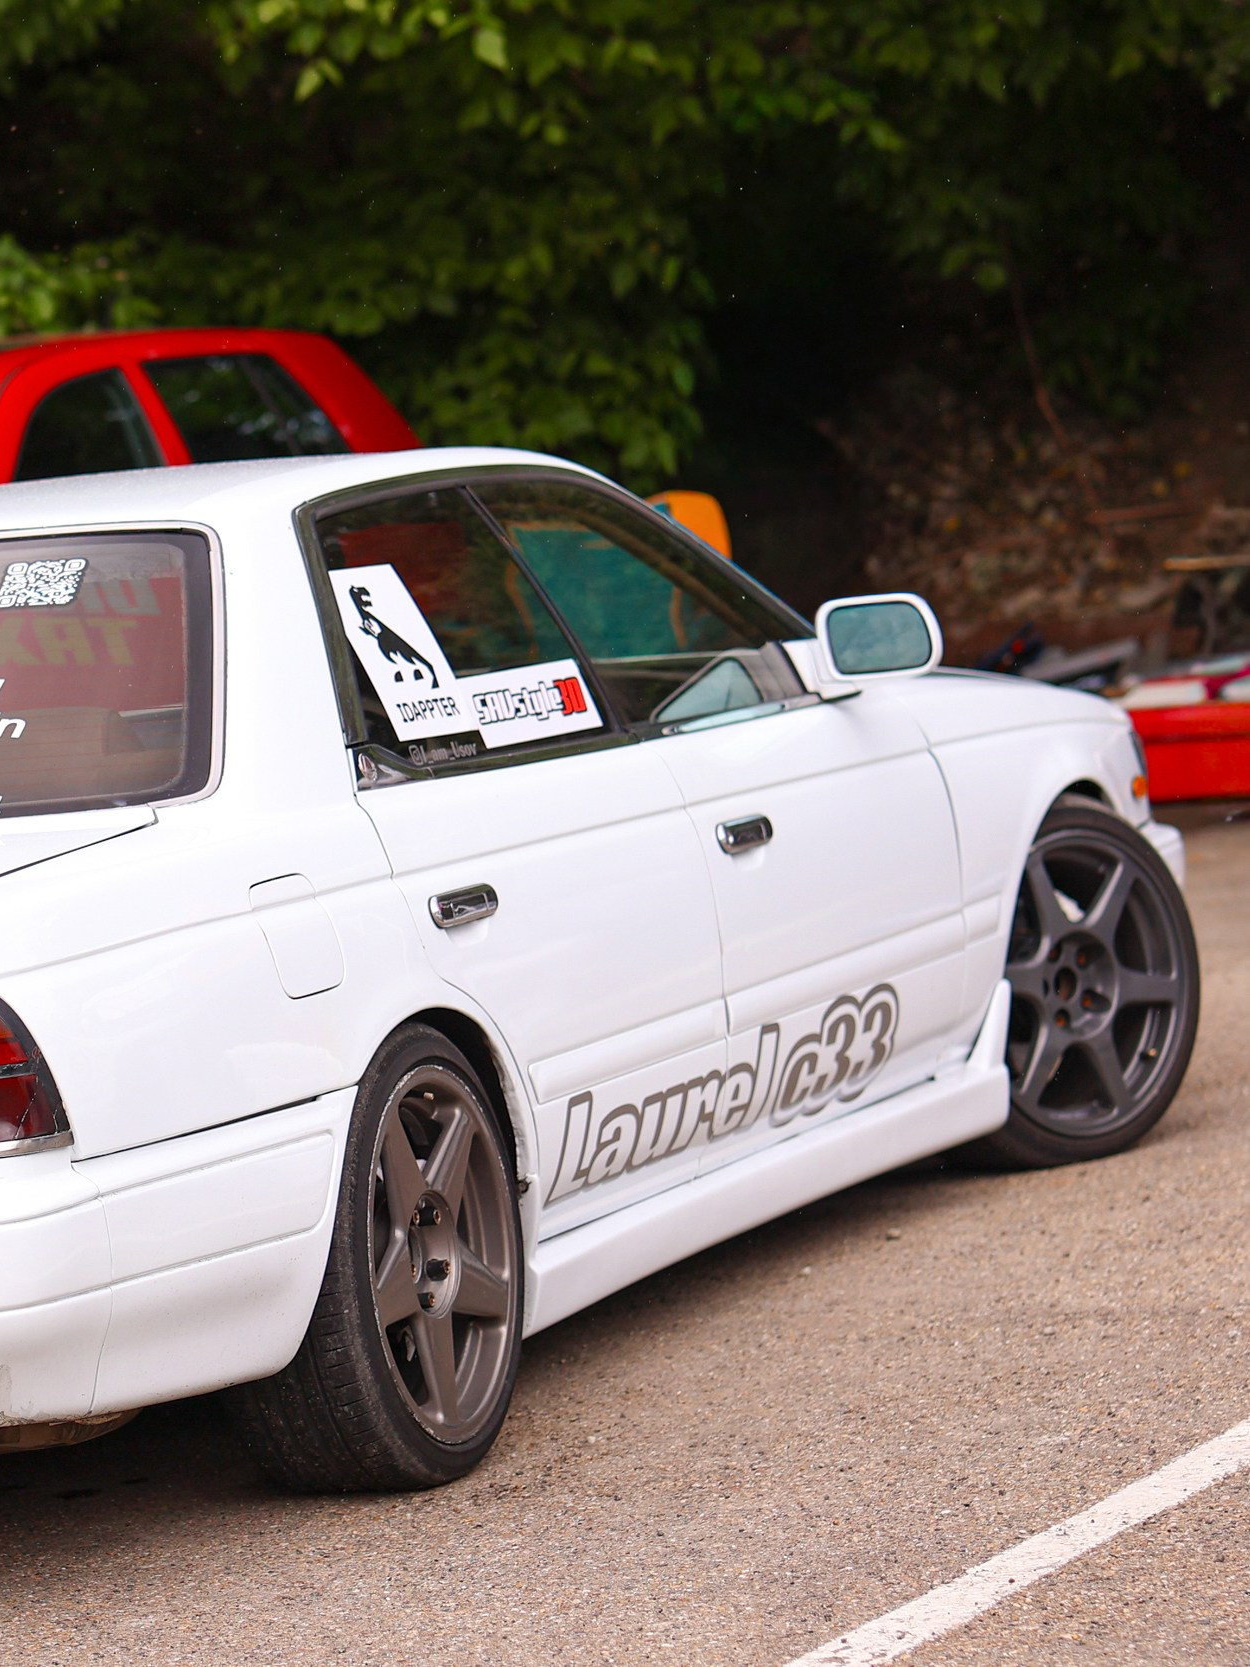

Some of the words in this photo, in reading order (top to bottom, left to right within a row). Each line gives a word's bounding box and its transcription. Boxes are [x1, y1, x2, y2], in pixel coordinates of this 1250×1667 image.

[396, 696, 461, 723] IDAPPTER
[543, 1021, 780, 1209] Laurel
[768, 983, 900, 1128] c33
